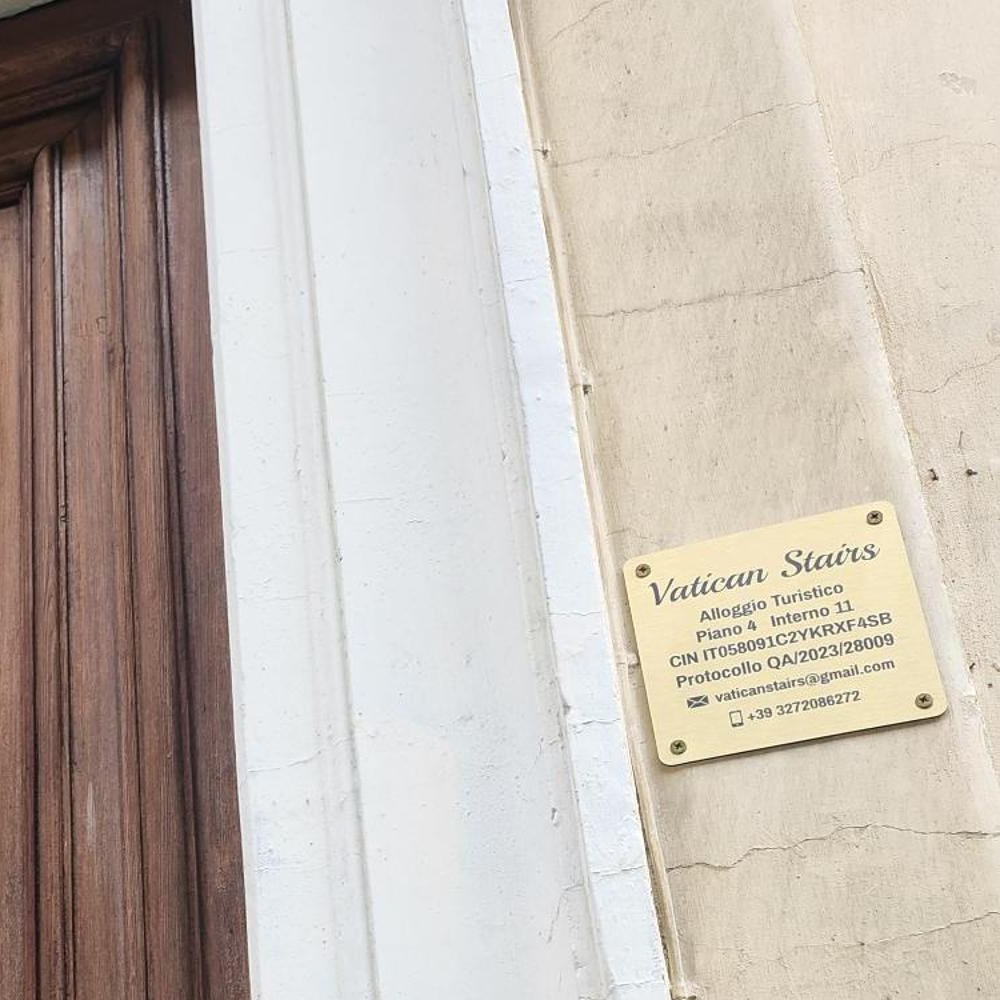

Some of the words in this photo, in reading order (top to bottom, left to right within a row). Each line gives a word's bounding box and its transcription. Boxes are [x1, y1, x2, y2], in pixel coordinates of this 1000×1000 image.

[649, 564, 768, 606] Vatican
[781, 543, 880, 578] Stairs
[696, 624, 742, 643] Piano
[747, 620, 757, 632] 4
[770, 606, 830, 628] Interno
[835, 600, 854, 614] 11
[700, 599, 767, 623] Alloggio
[771, 583, 844, 607] Turistico
[669, 651, 698, 668] CIN
[703, 612, 892, 661] IT058091C2YKRXF4SB
[676, 661, 762, 688] Protocollo
[767, 633, 895, 669] QA/2023/28009
[715, 659, 895, 703] vaticanstairs@gmail.com
[747, 707, 773, 721] +39
[776, 690, 861, 717] 3272086272
